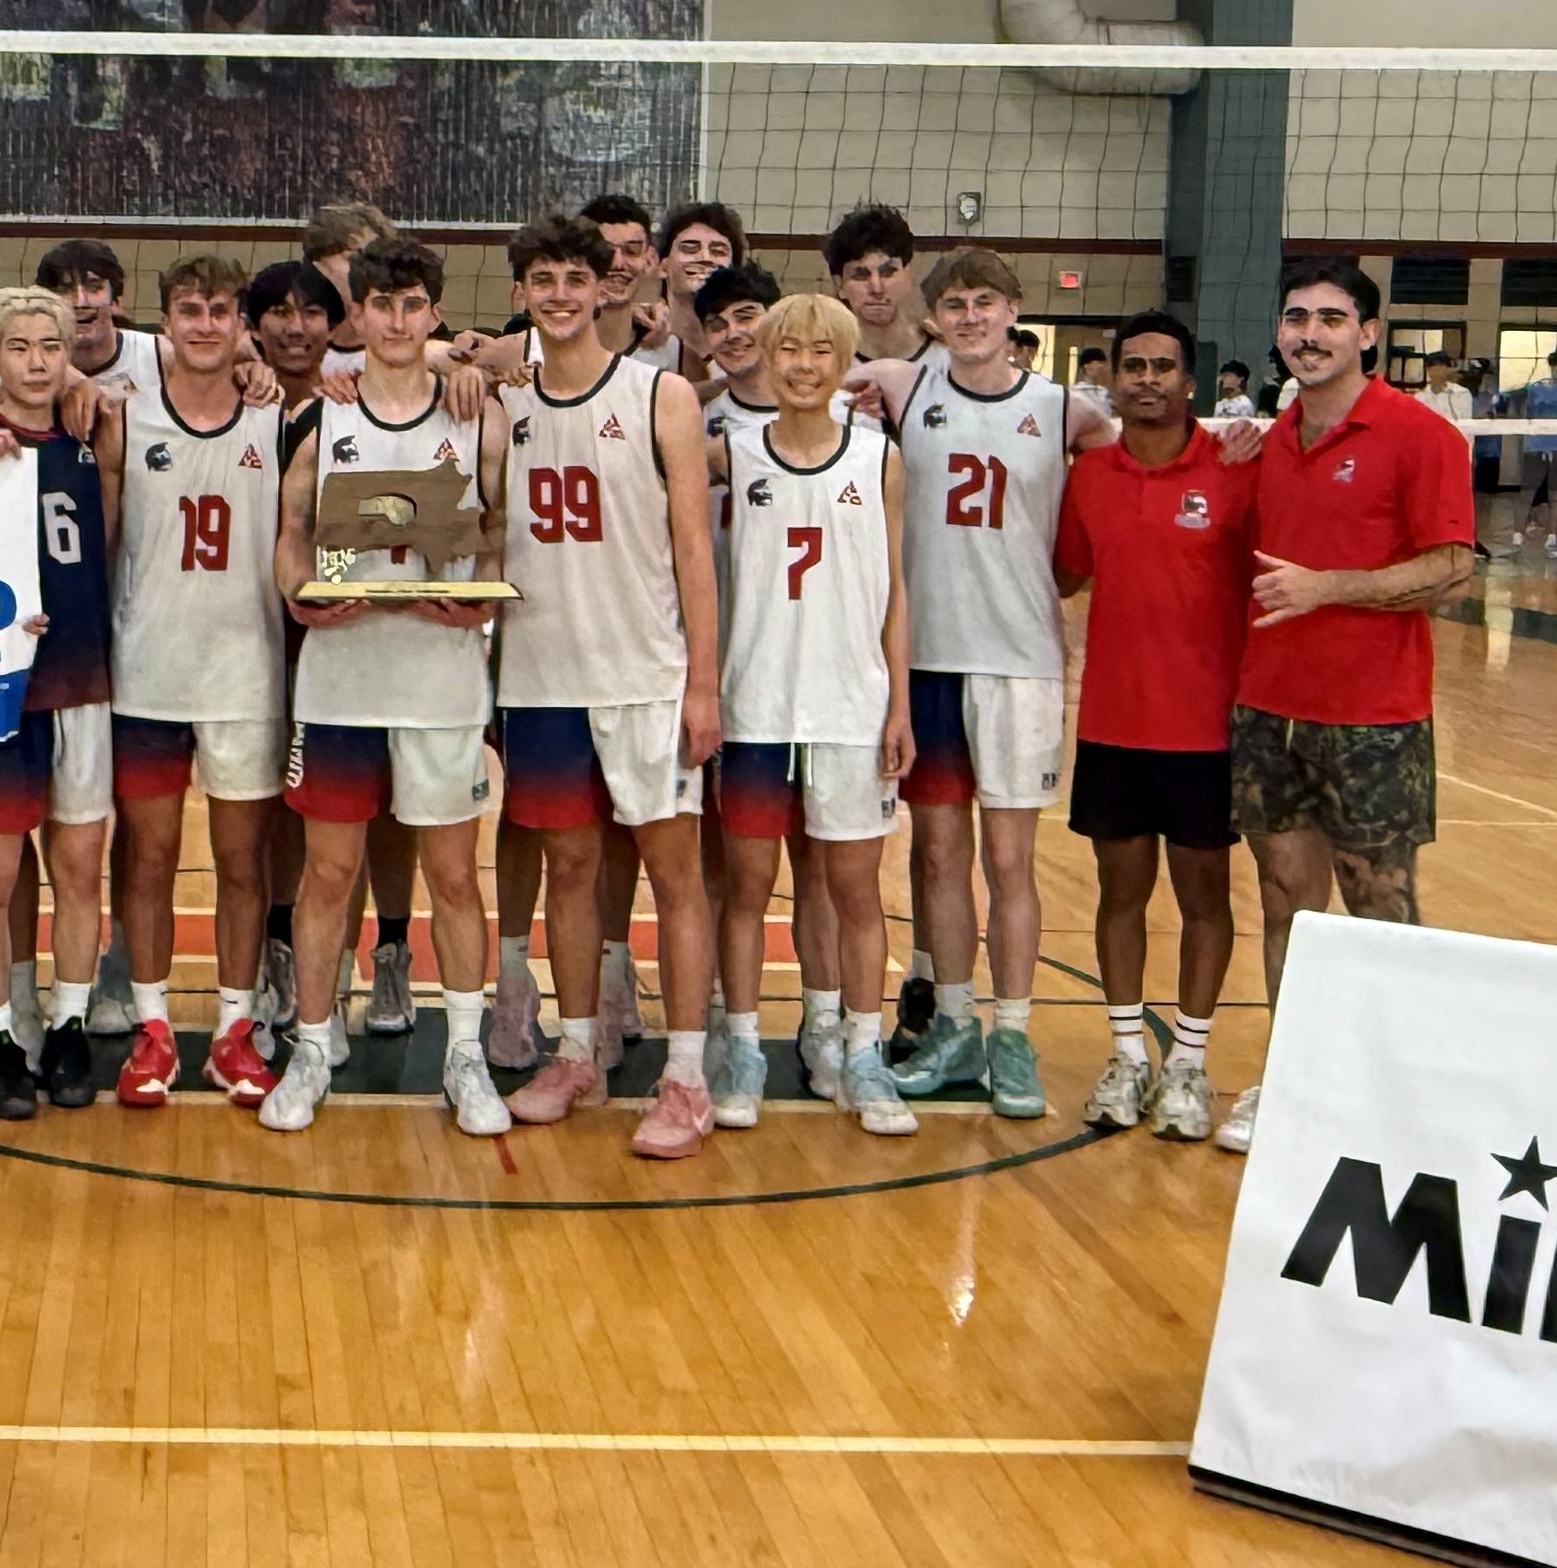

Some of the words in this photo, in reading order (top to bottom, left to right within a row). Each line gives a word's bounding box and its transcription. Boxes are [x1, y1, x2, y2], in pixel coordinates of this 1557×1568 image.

[528, 465, 604, 544] 99
[945, 452, 1008, 530] 21
[179, 494, 231, 572] 19
[786, 526, 824, 601] 7
